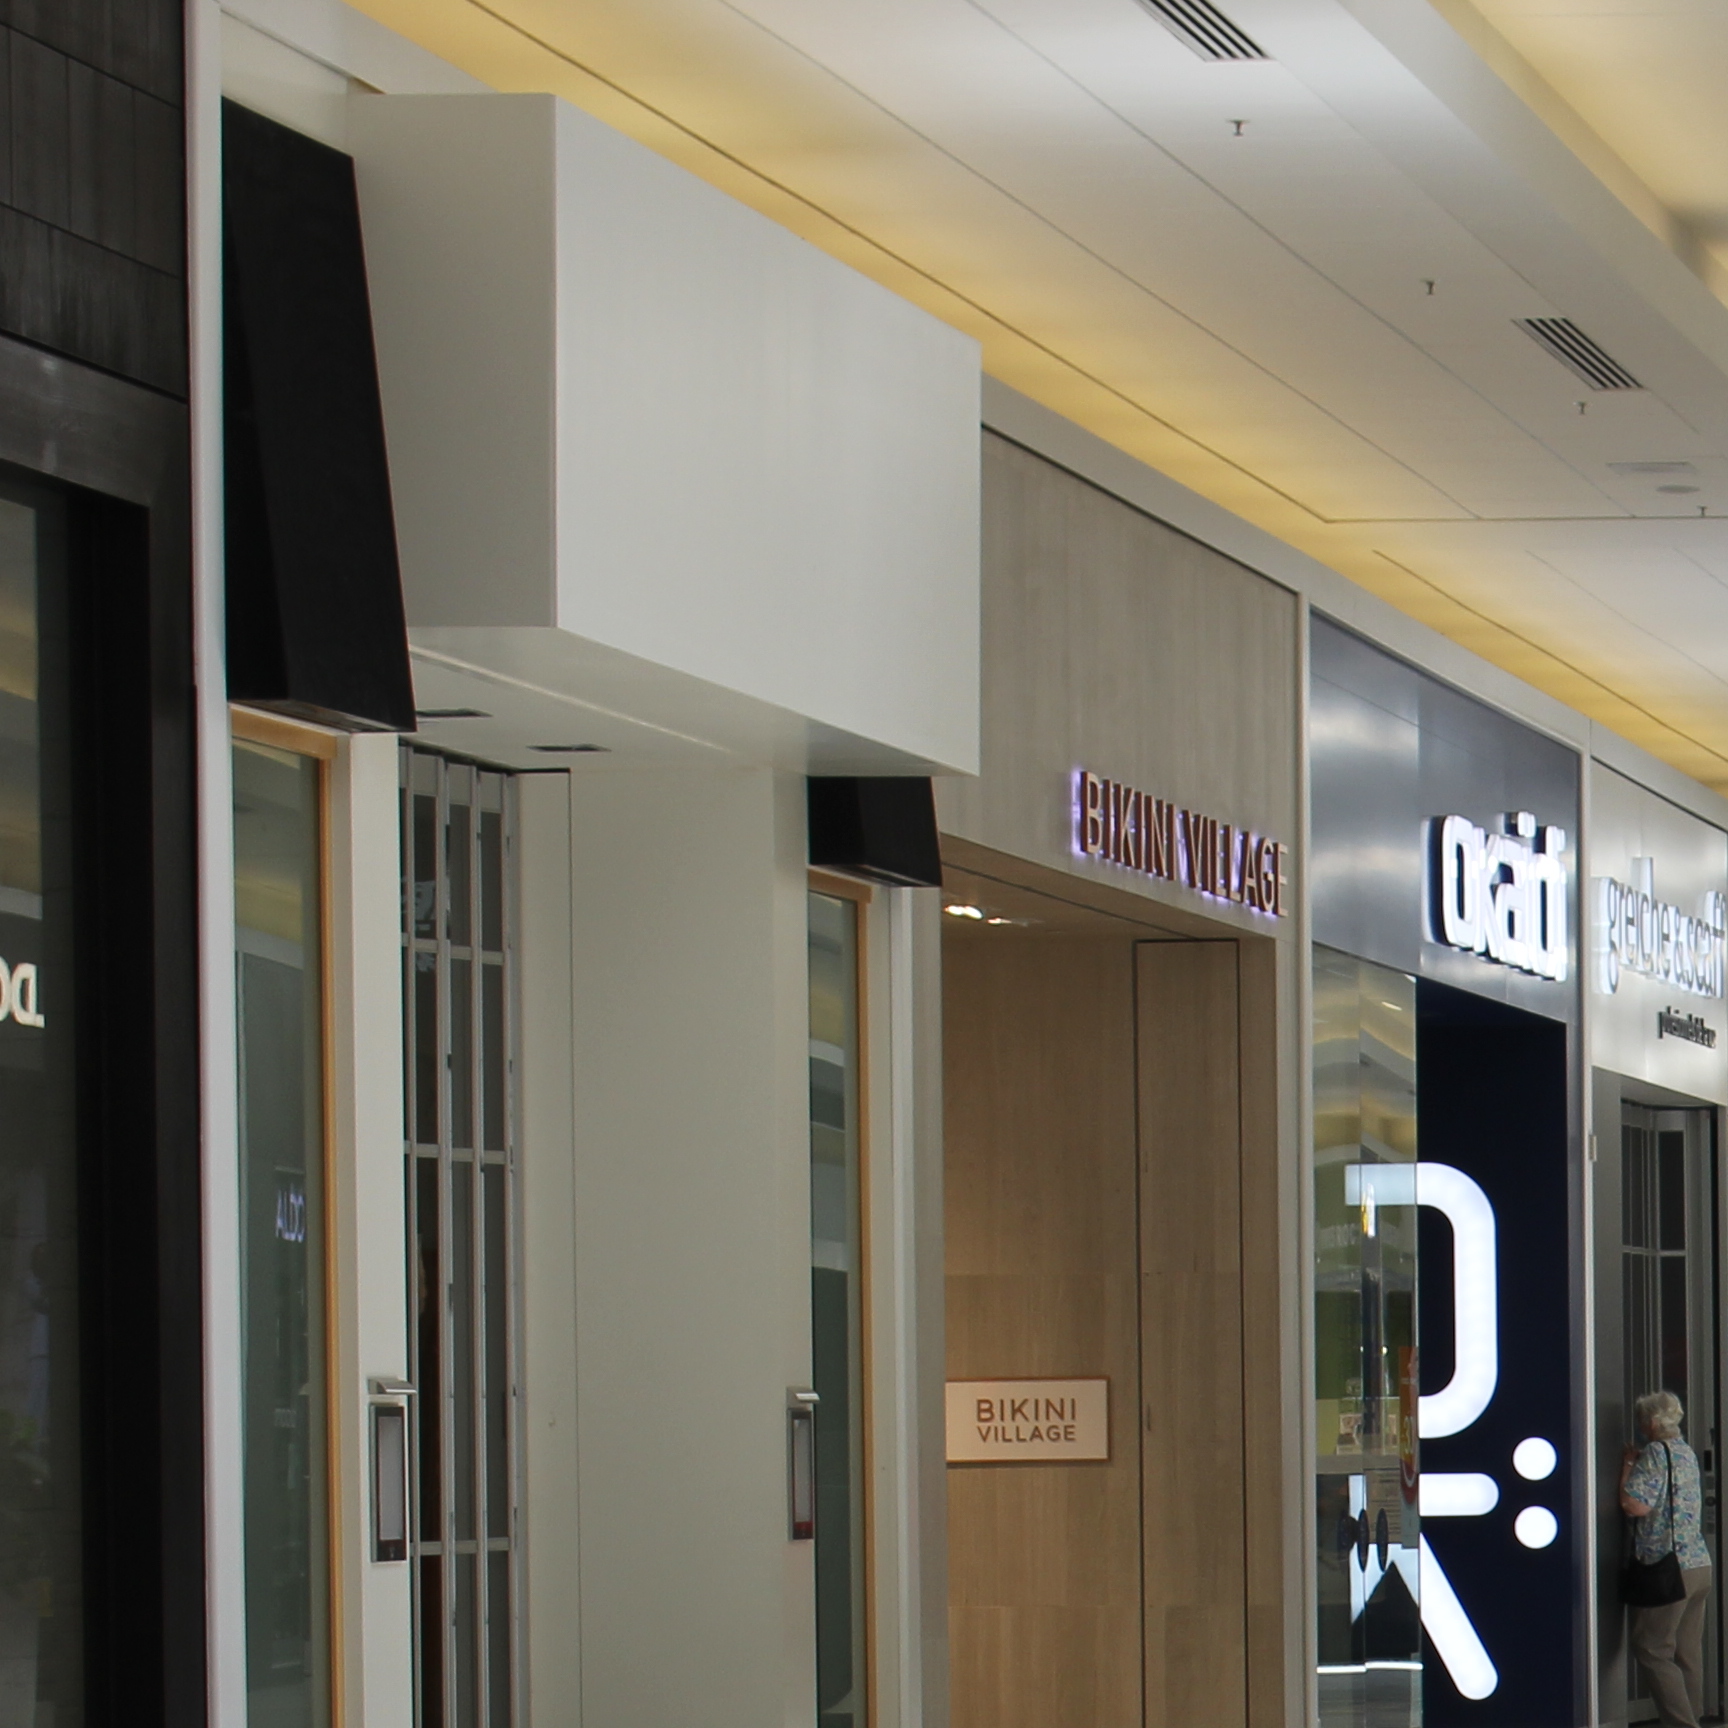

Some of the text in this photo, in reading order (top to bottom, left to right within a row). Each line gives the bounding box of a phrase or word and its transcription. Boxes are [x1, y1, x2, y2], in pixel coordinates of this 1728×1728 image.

[1079, 771, 1288, 918] BIKINI VILLAGE
[976, 1398, 1077, 1423] BIKINI
[976, 1424, 1077, 1444] VILLAGE
